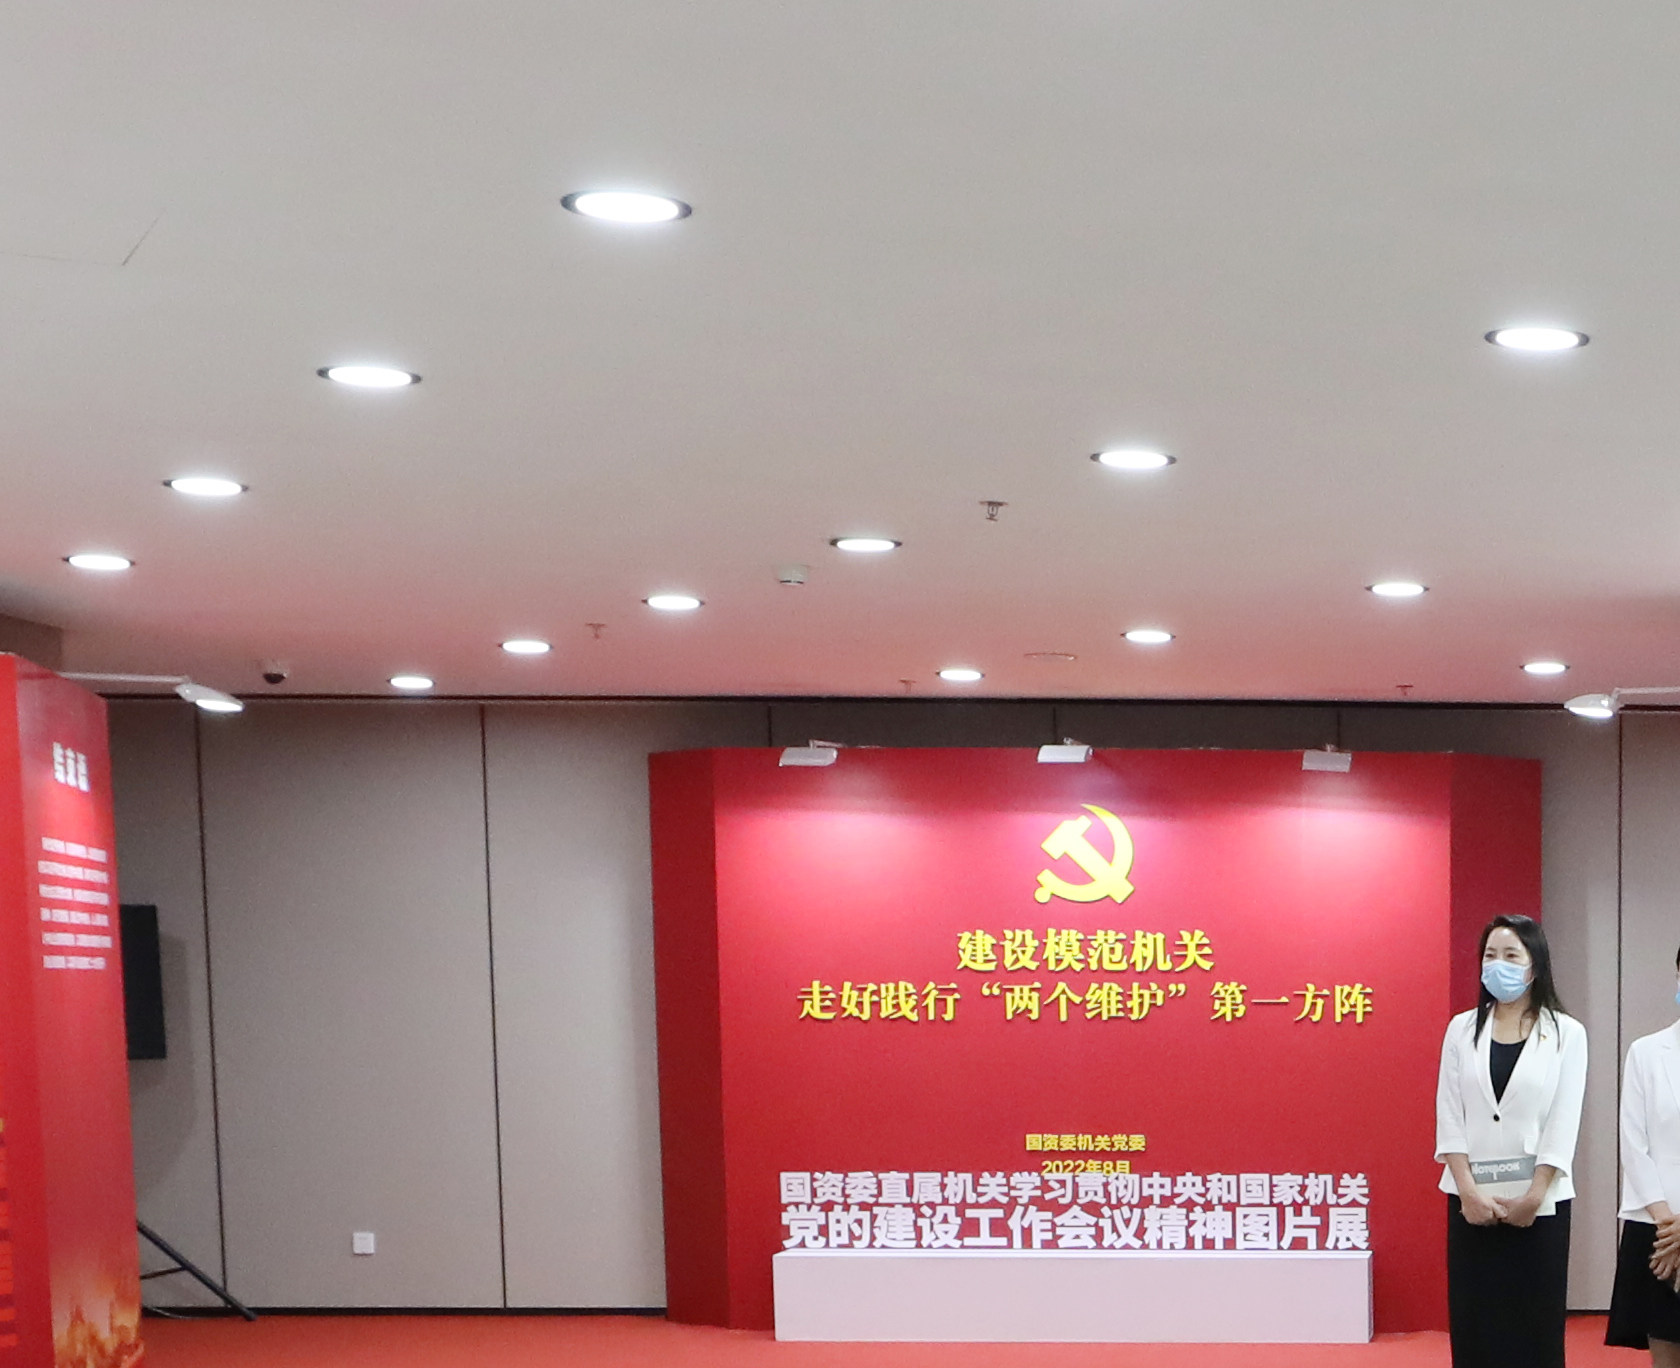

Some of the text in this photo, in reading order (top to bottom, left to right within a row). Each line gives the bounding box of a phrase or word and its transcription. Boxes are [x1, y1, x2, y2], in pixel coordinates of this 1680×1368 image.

[956, 928, 1216, 975] 建设模范机关
[797, 980, 1375, 1026] 走好践行“两个维护”第一方阵
[1025, 1133, 1147, 1153] 国资委机关党委
[1041, 1159, 1132, 1174] 2022年8月
[779, 1172, 1370, 1206] 国资委直属机关学习贯彻中央和国家机关
[781, 1207, 1370, 1252] 党的建设工作会议精神图片展
